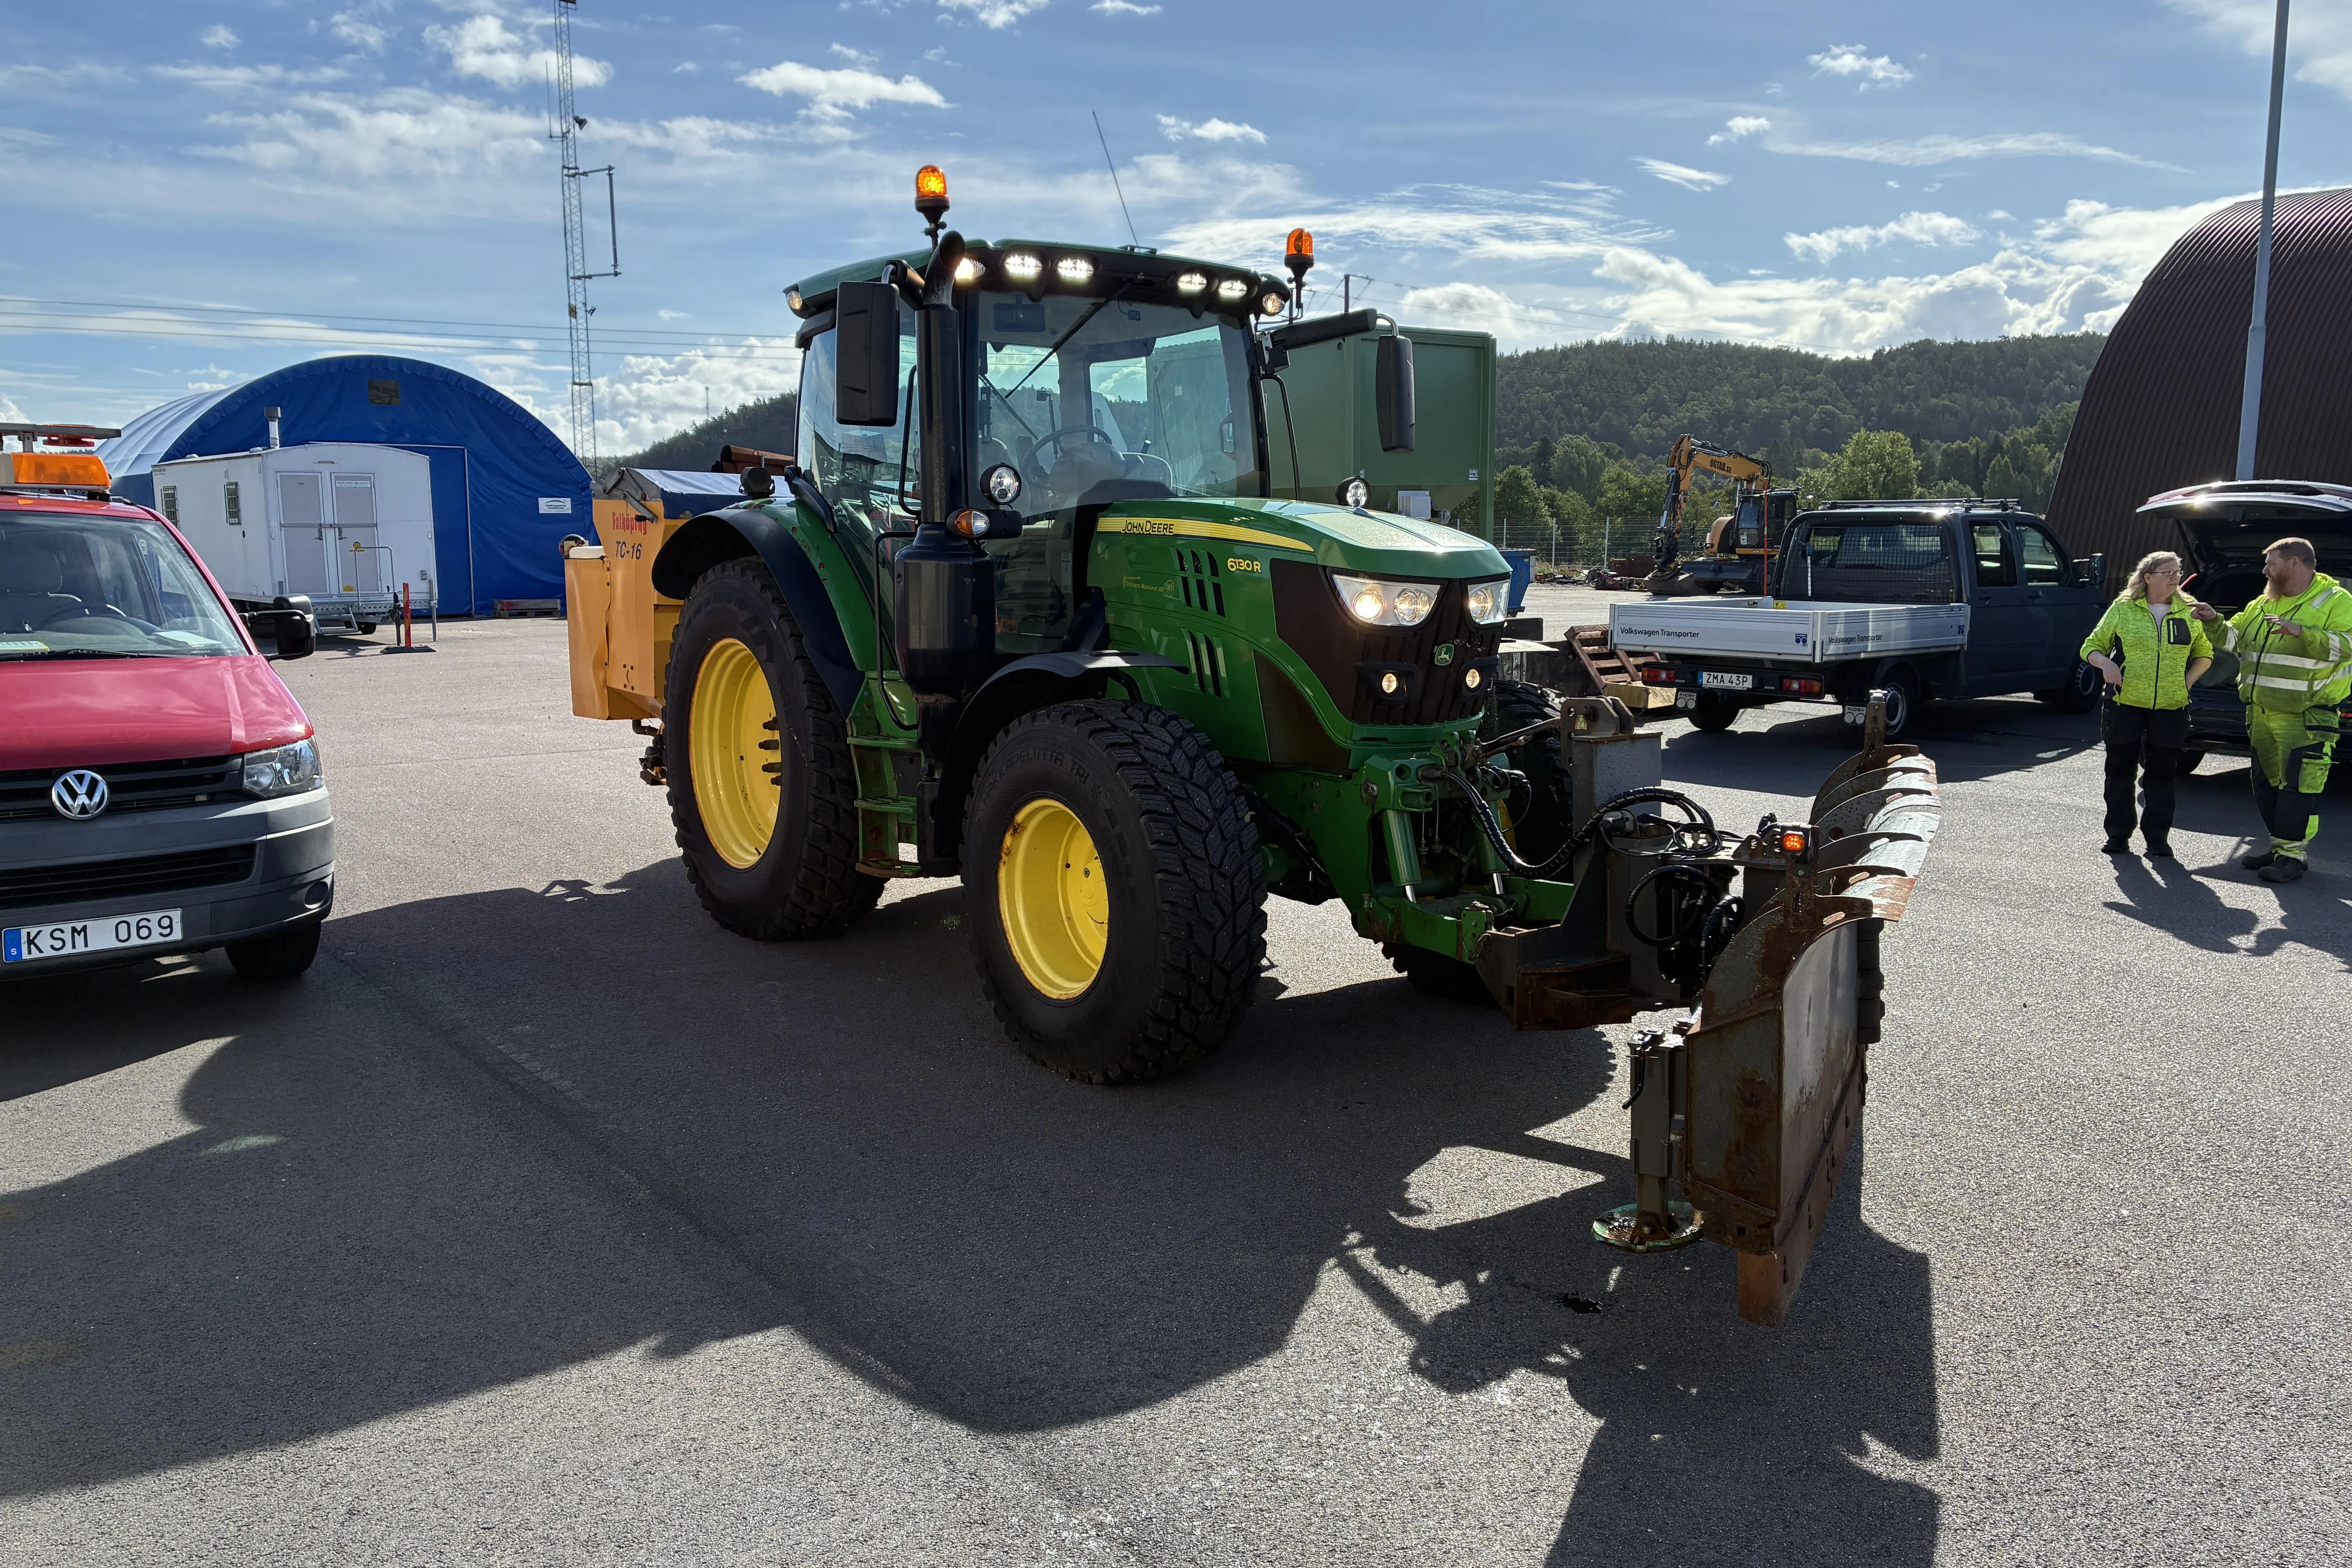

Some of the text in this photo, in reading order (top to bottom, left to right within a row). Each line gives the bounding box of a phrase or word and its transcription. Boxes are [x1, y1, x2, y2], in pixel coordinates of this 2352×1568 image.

[1122, 520, 1174, 534] JOHN DEERE
[616, 541, 642, 560] TC-16
[1620, 627, 1700, 638] Volkswagen Transporter
[1829, 636, 1856, 644] Volkswagen
[1706, 673, 1748, 686] ZMA 43P
[26, 915, 173, 955] KSM 069
